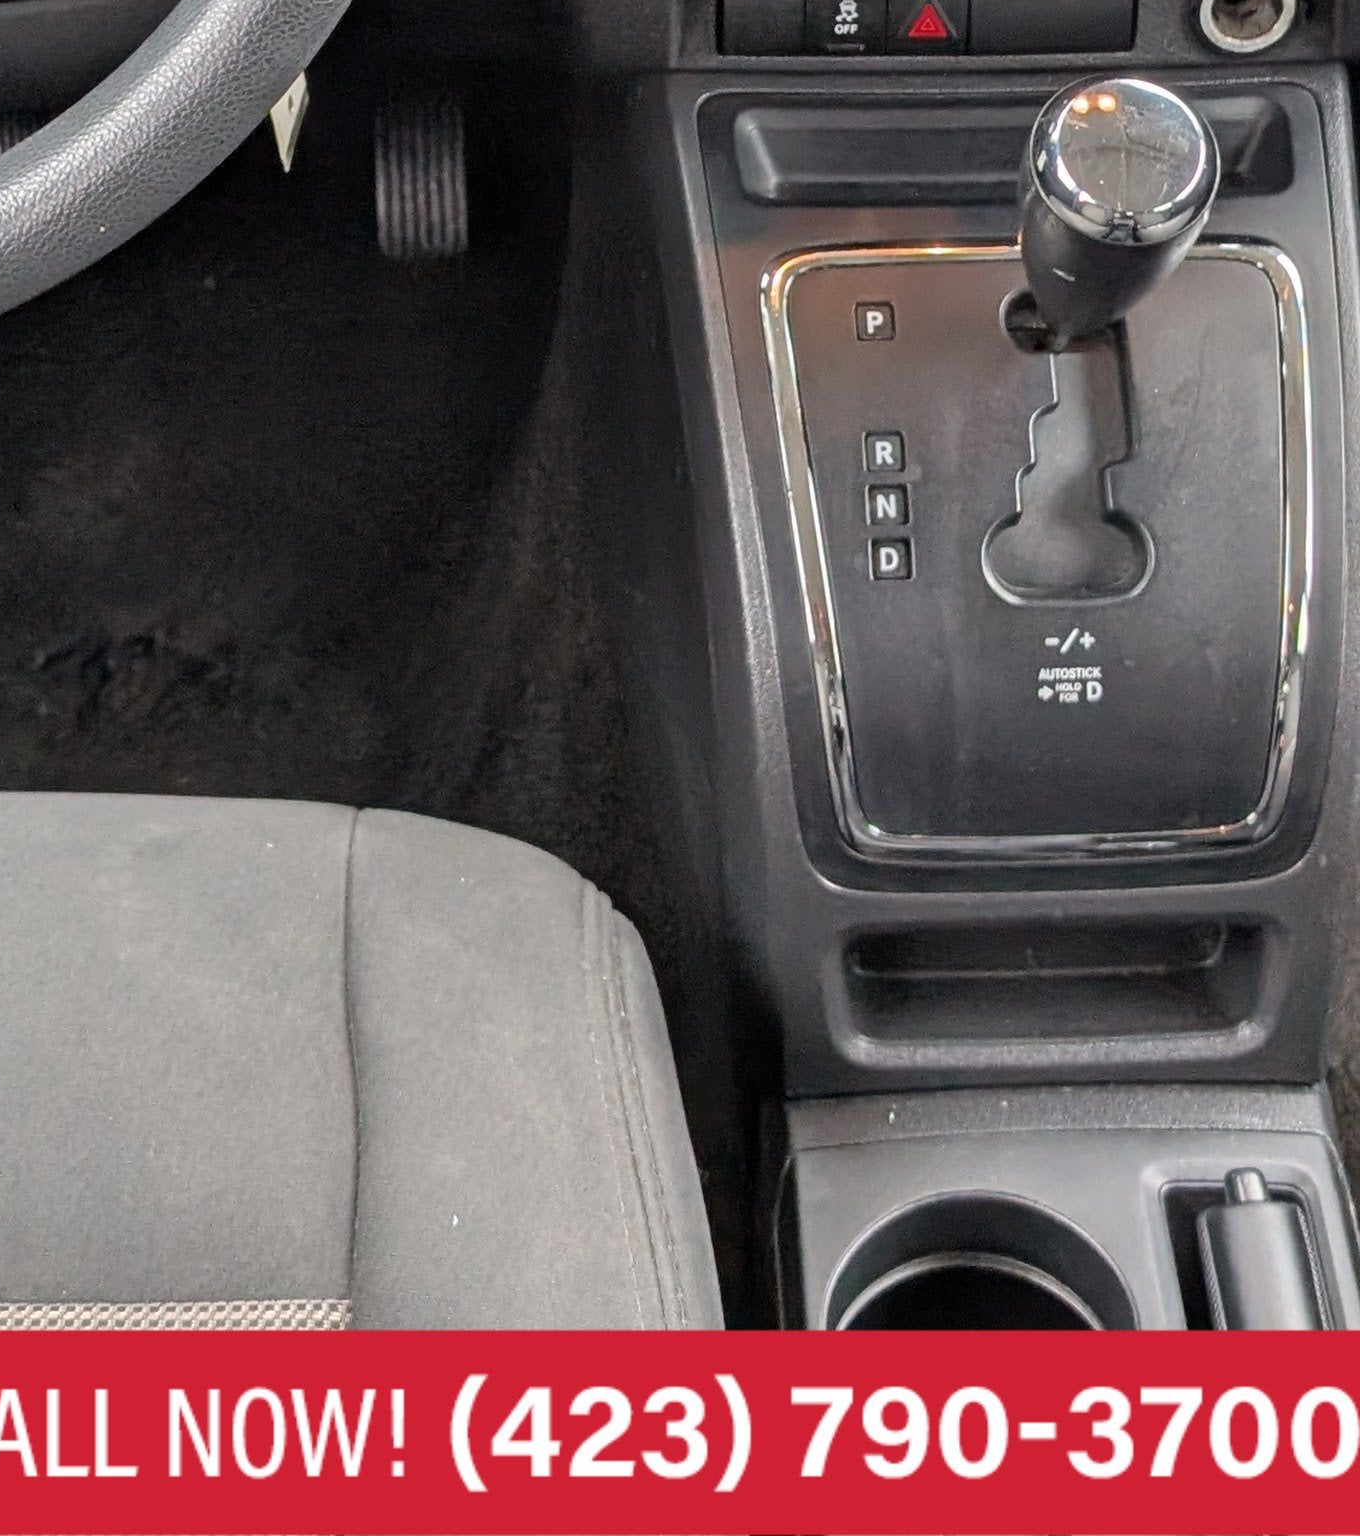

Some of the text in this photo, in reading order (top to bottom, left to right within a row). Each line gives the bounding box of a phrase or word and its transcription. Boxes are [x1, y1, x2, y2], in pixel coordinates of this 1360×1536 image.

[834, 24, 859, 35] OFF
[866, 310, 885, 334] P
[875, 442, 895, 465] R
[876, 495, 897, 519] N
[879, 547, 900, 571] D
[1038, 666, 1103, 682] AUTOSTICK
[1055, 681, 1103, 702] HOLD D
[1059, 692, 1080, 703] FOR
